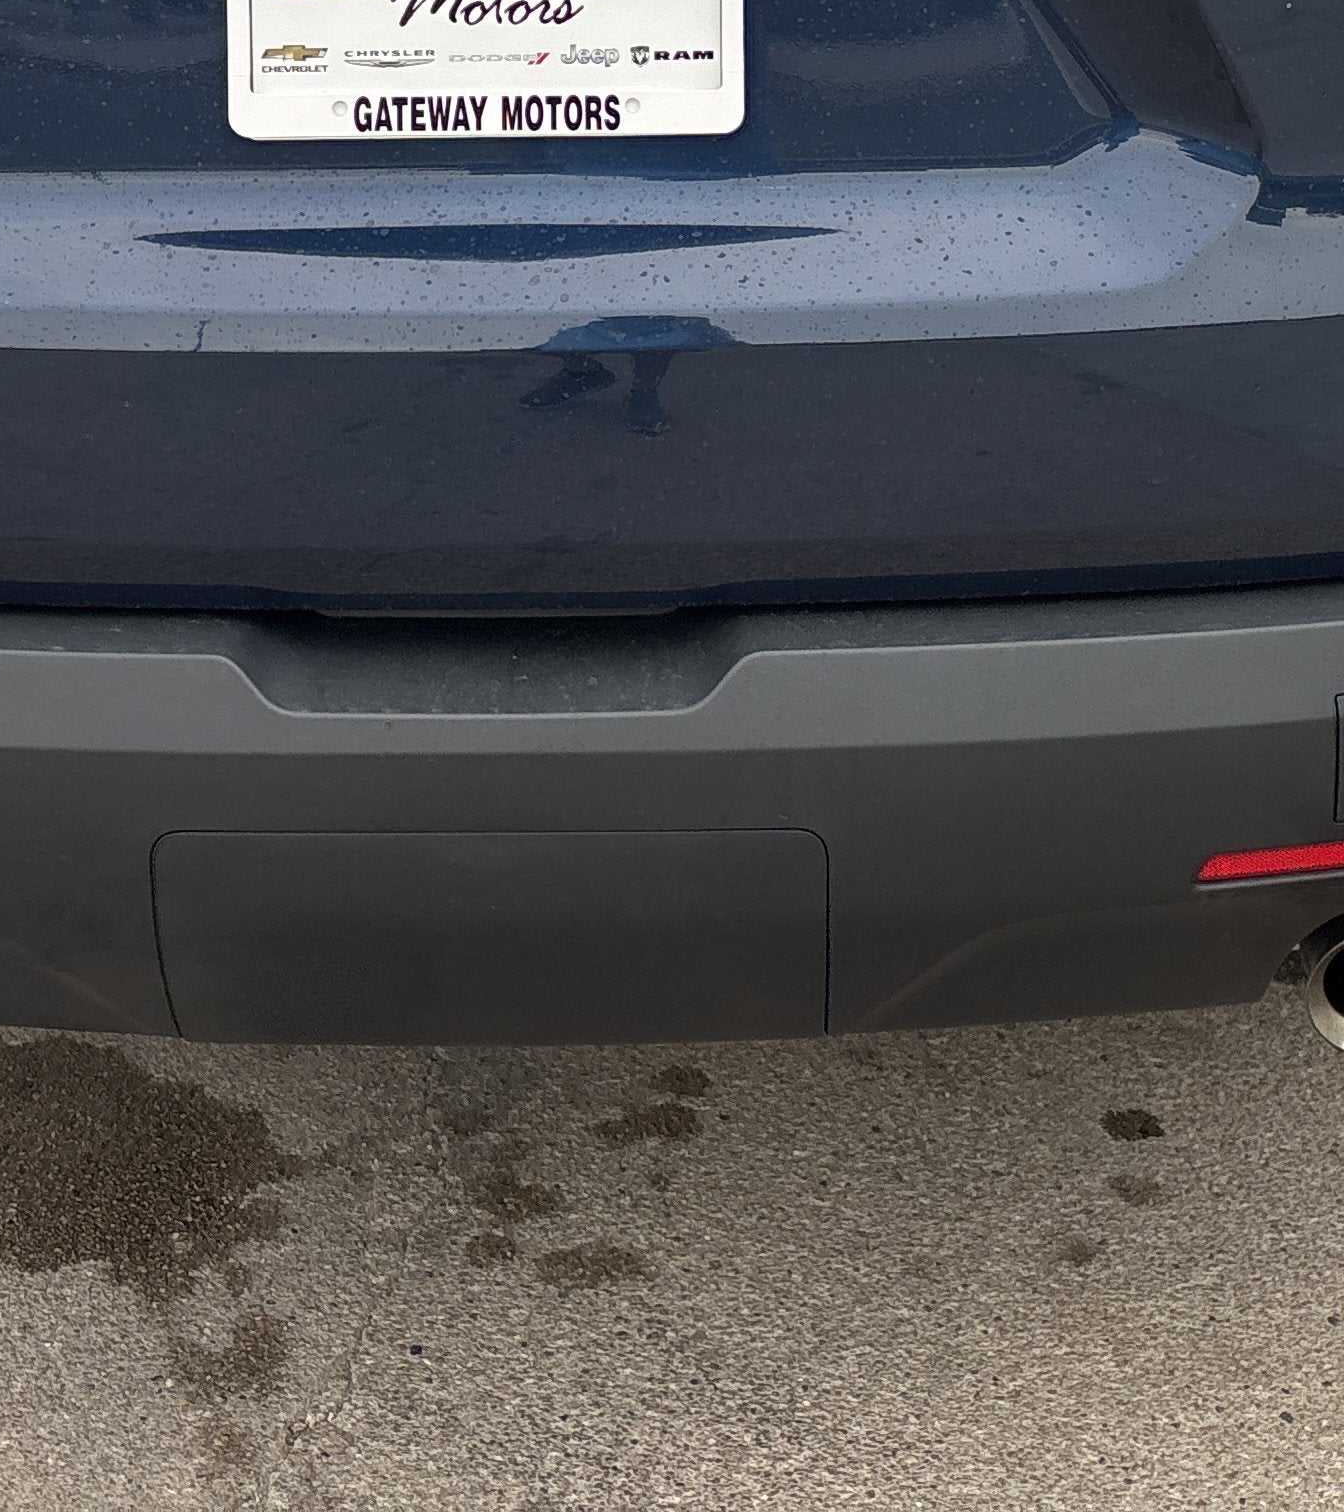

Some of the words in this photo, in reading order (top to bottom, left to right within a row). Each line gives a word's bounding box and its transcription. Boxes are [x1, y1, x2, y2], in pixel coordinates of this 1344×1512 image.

[344, 49, 436, 57] CHRYSLER
[560, 44, 620, 67] Jeep
[654, 50, 715, 61] RAM
[448, 54, 536, 62] DODGE
[261, 65, 329, 73] CHEVROLET
[353, 95, 488, 133] GATEWAY
[501, 94, 621, 131] MOTORS
